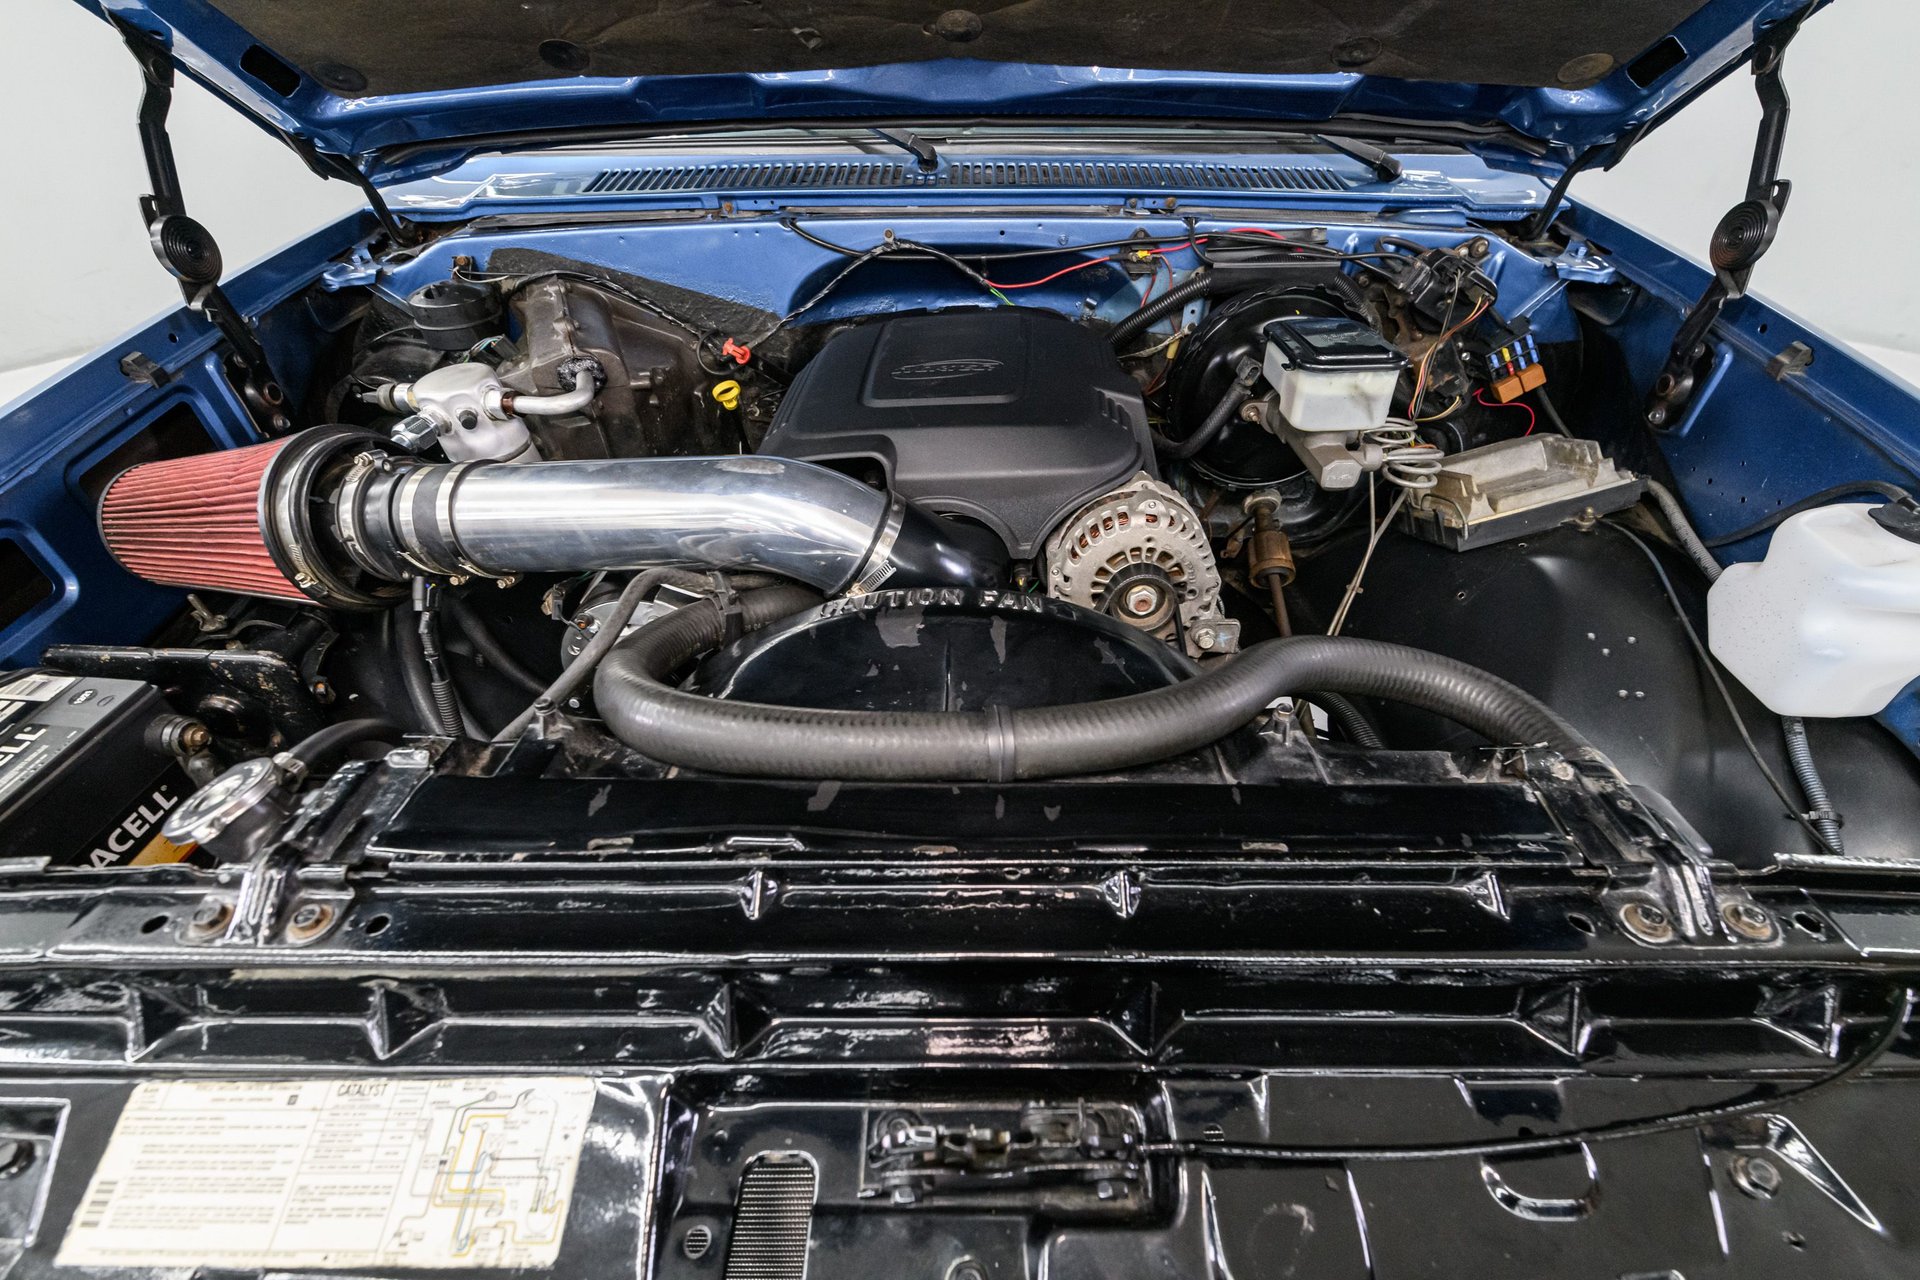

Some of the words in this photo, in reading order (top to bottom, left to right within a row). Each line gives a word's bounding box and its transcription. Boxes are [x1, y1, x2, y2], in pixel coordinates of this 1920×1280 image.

[819, 588, 964, 617] CAUTION
[980, 590, 1043, 613] FAN
[79, 791, 178, 868] ACELL
[337, 1083, 389, 1097] CATALYST
